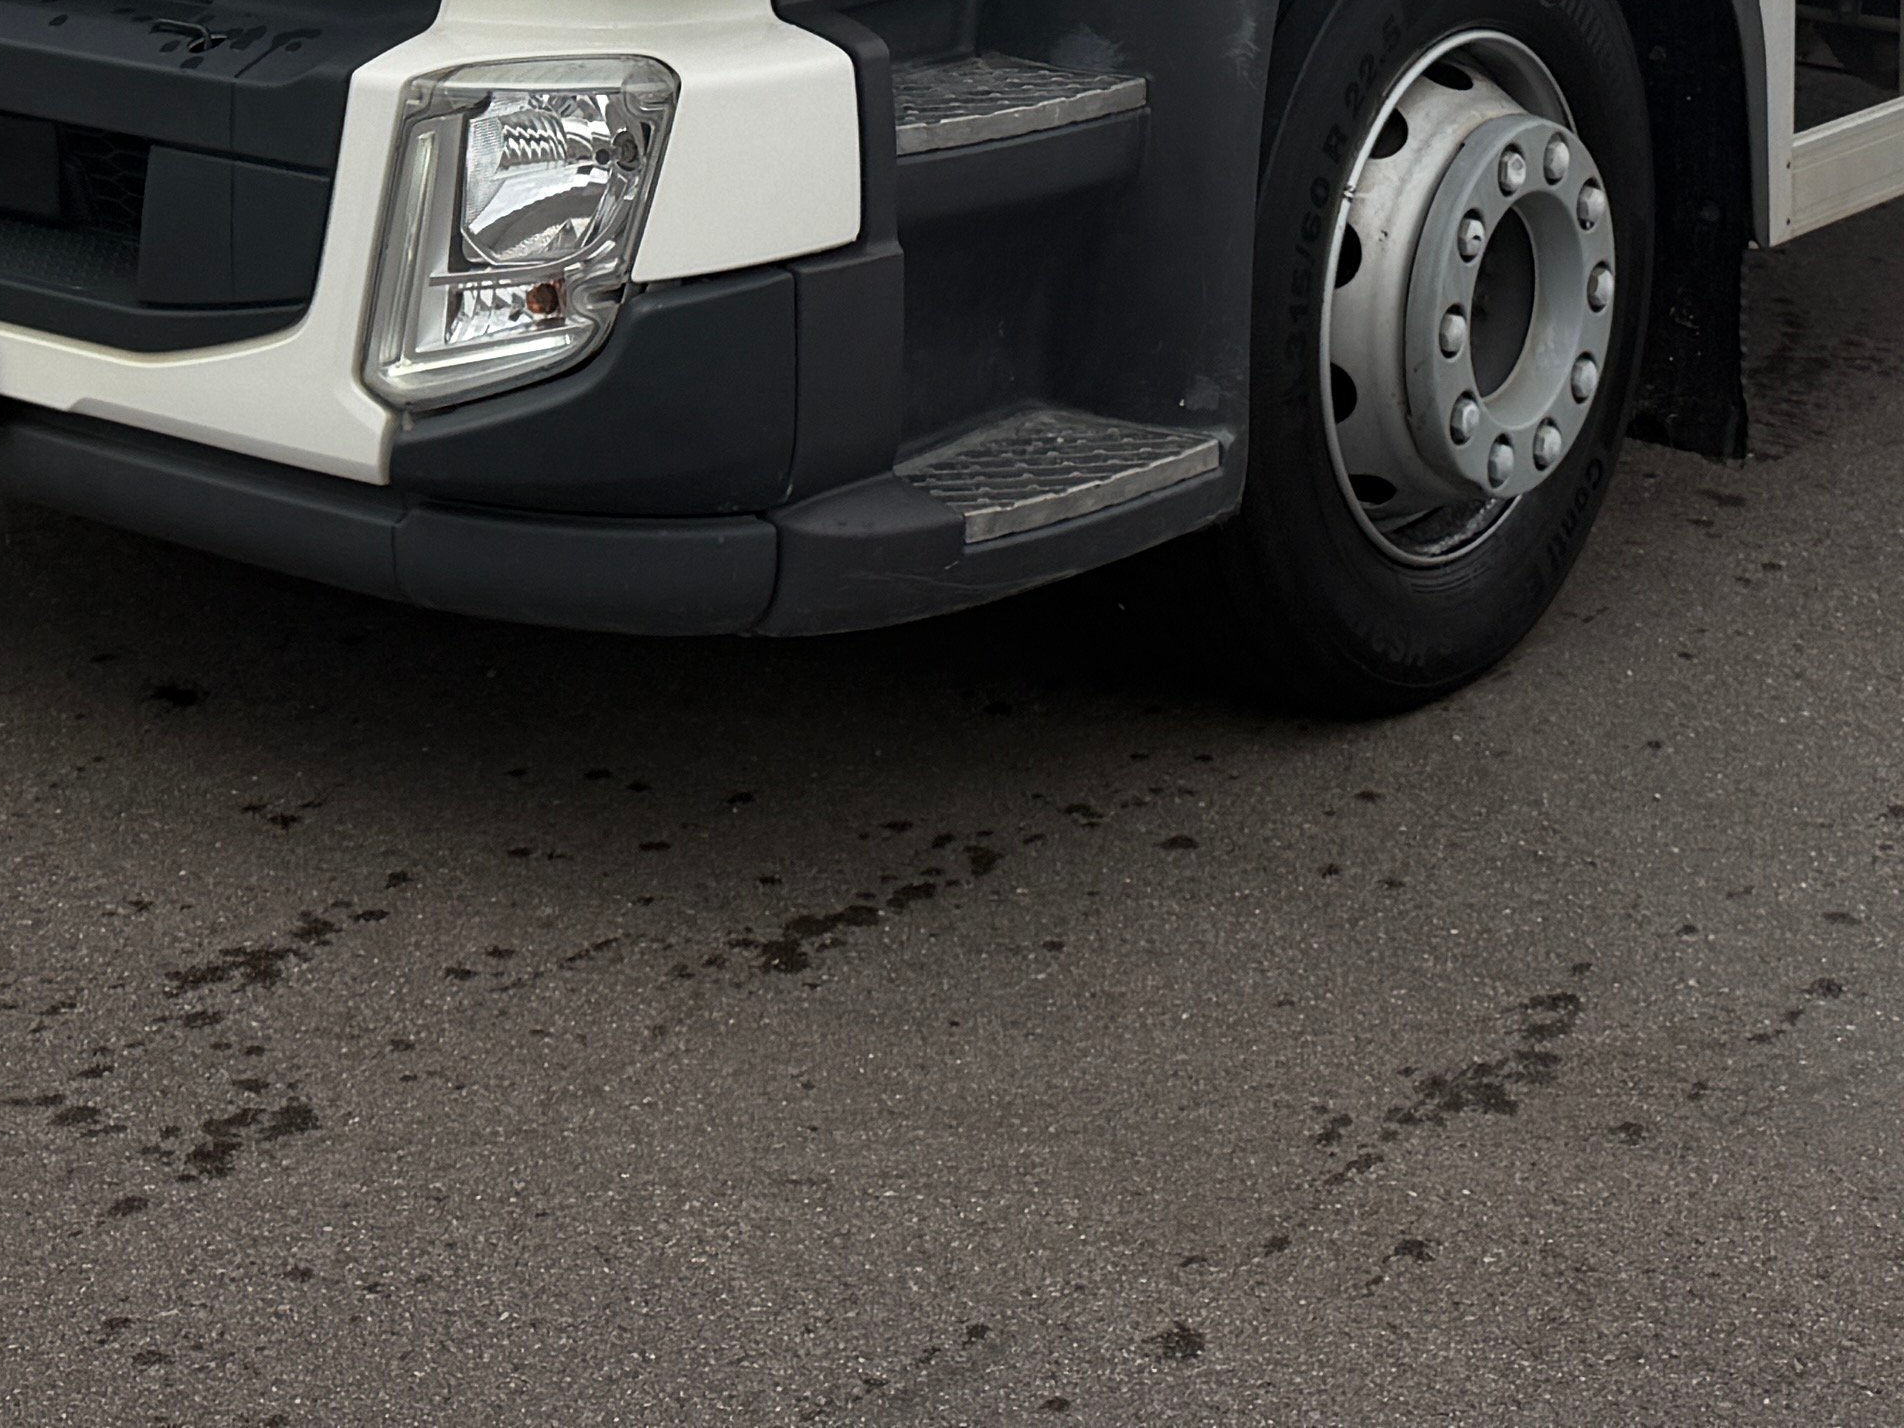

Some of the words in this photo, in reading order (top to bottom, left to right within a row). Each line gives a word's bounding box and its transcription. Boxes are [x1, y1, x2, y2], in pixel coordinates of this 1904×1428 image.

[1286, 175, 1331, 361] 315/60
[1323, 123, 1348, 164] R
[1343, 14, 1402, 120] 22.5
